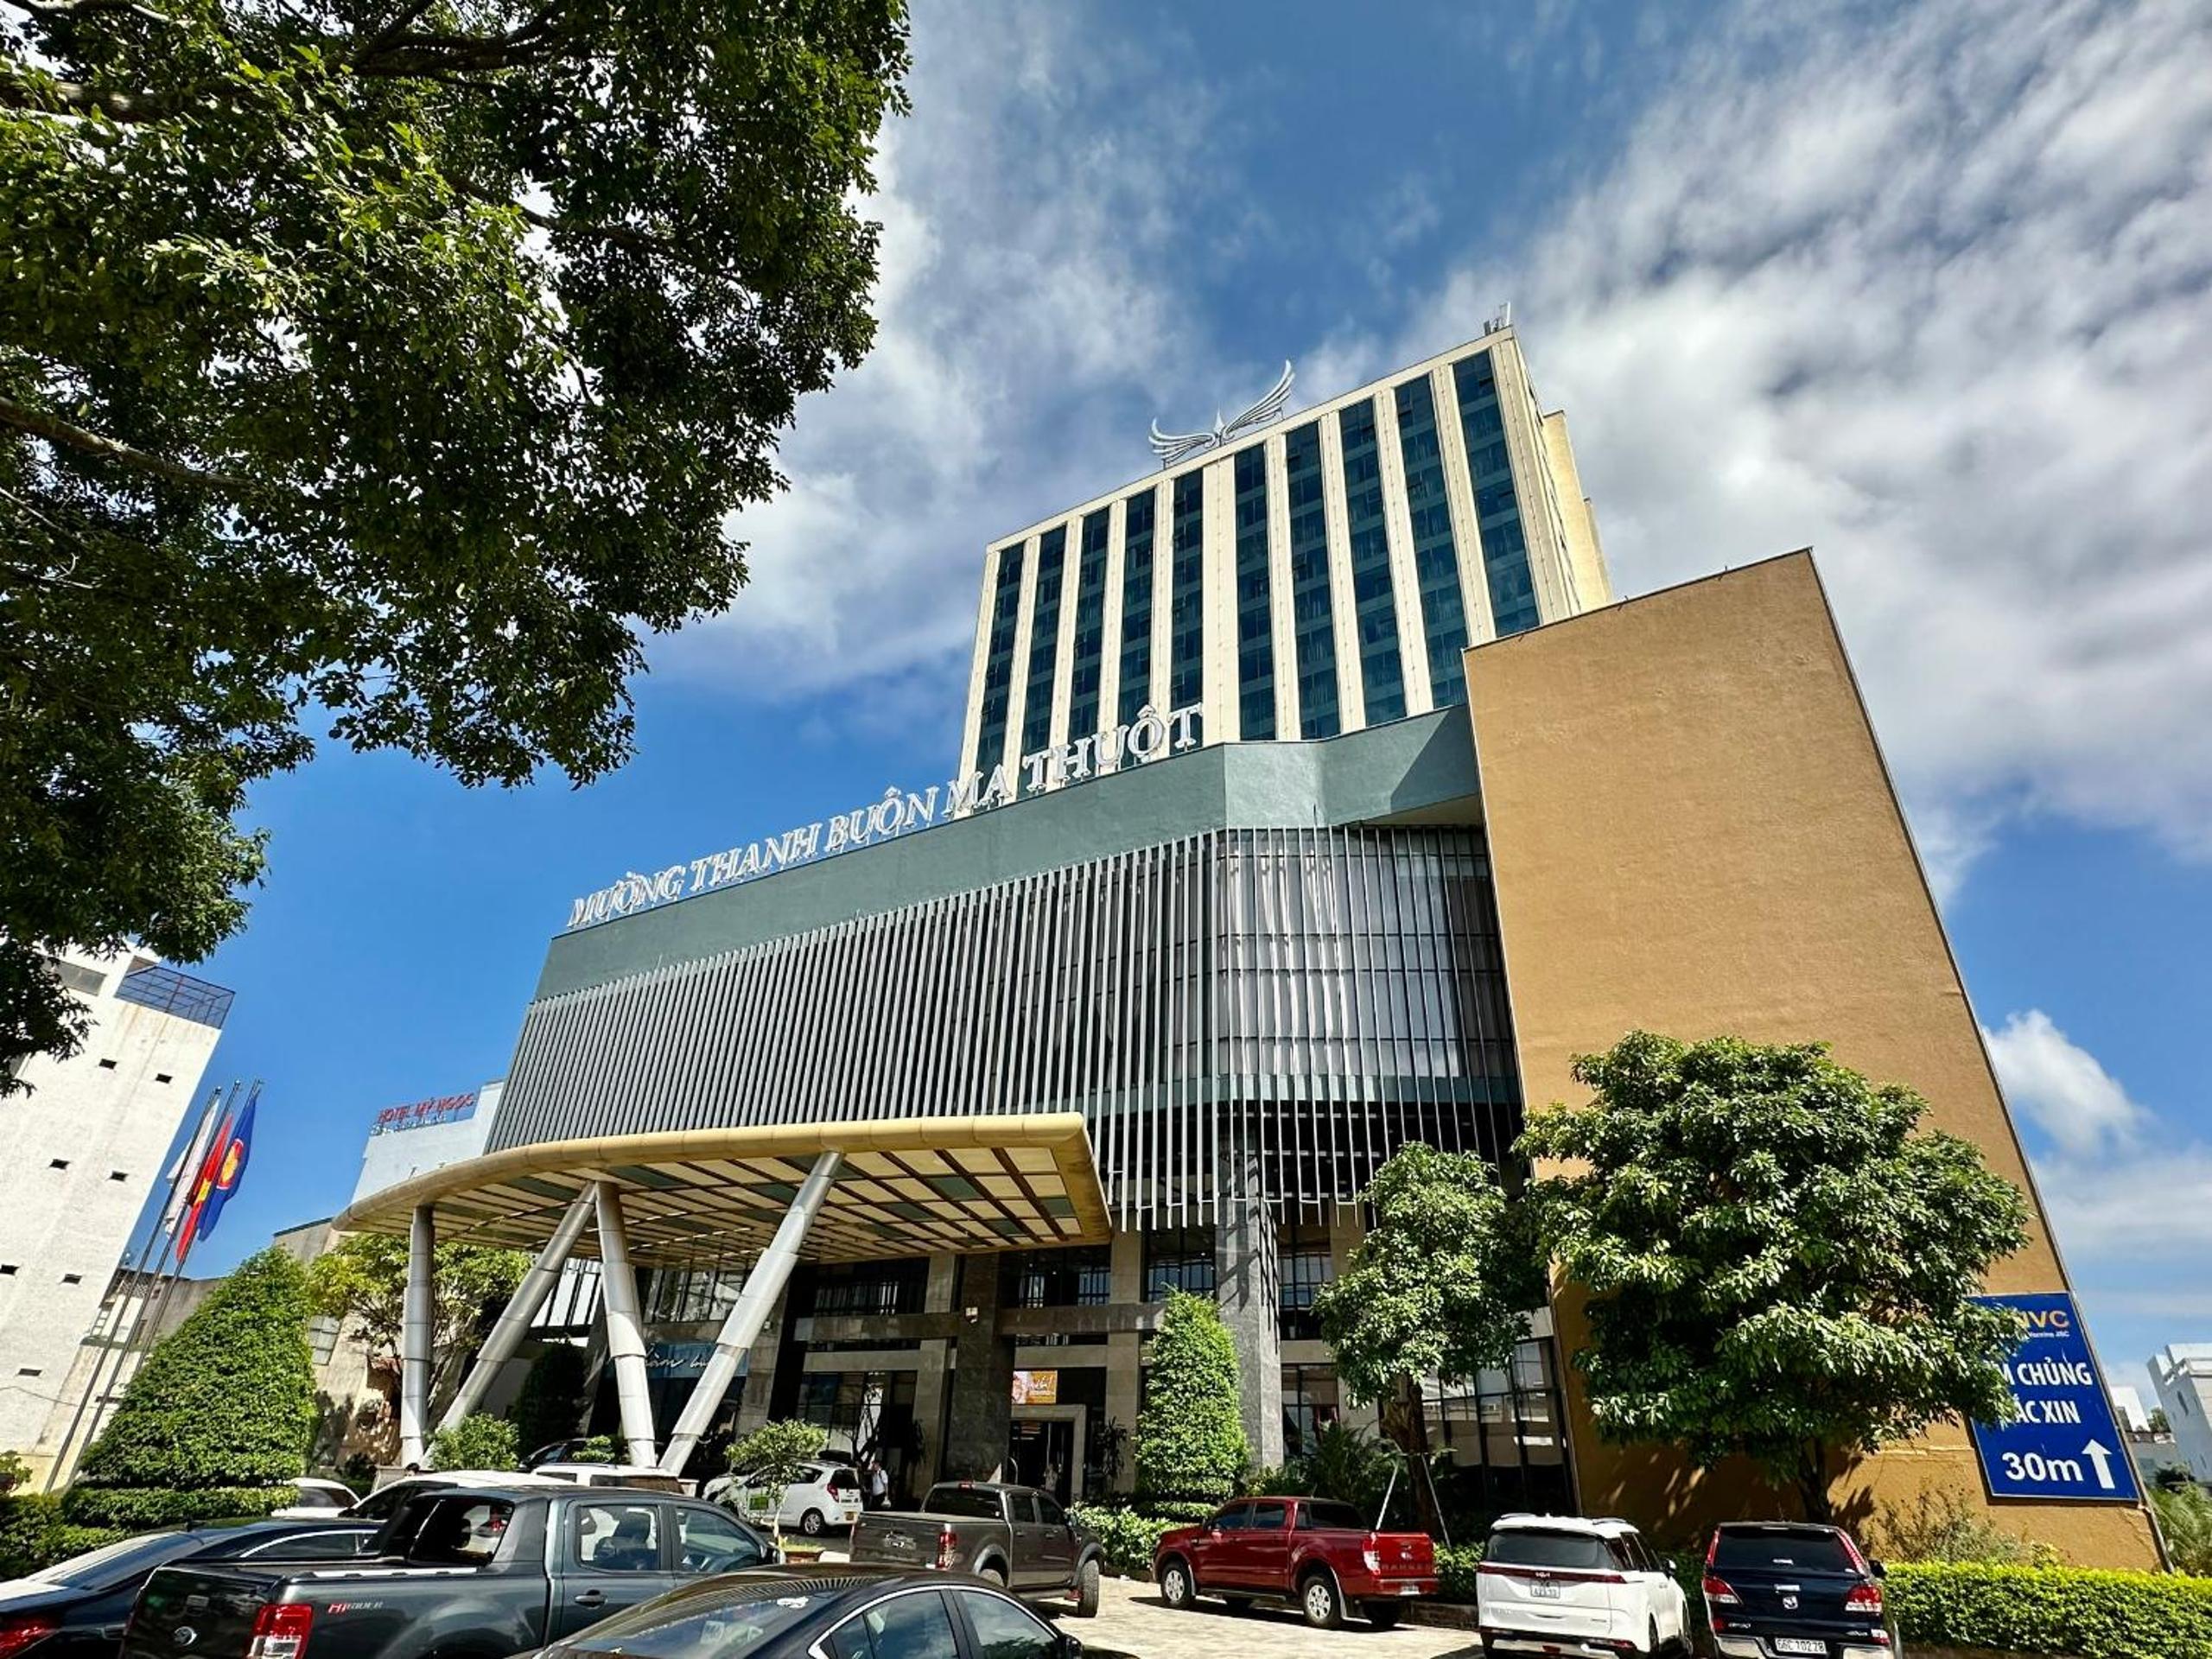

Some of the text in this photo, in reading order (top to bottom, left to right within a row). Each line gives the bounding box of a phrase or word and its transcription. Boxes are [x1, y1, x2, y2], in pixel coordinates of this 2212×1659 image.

[567, 702, 1204, 926] MƯỜNG THANH BUÔN MA THUỘT
[2017, 1356, 2093, 1386] CHỦNG
[2039, 1400, 2082, 1424] XIN
[2001, 1452, 2084, 1482] 30m
